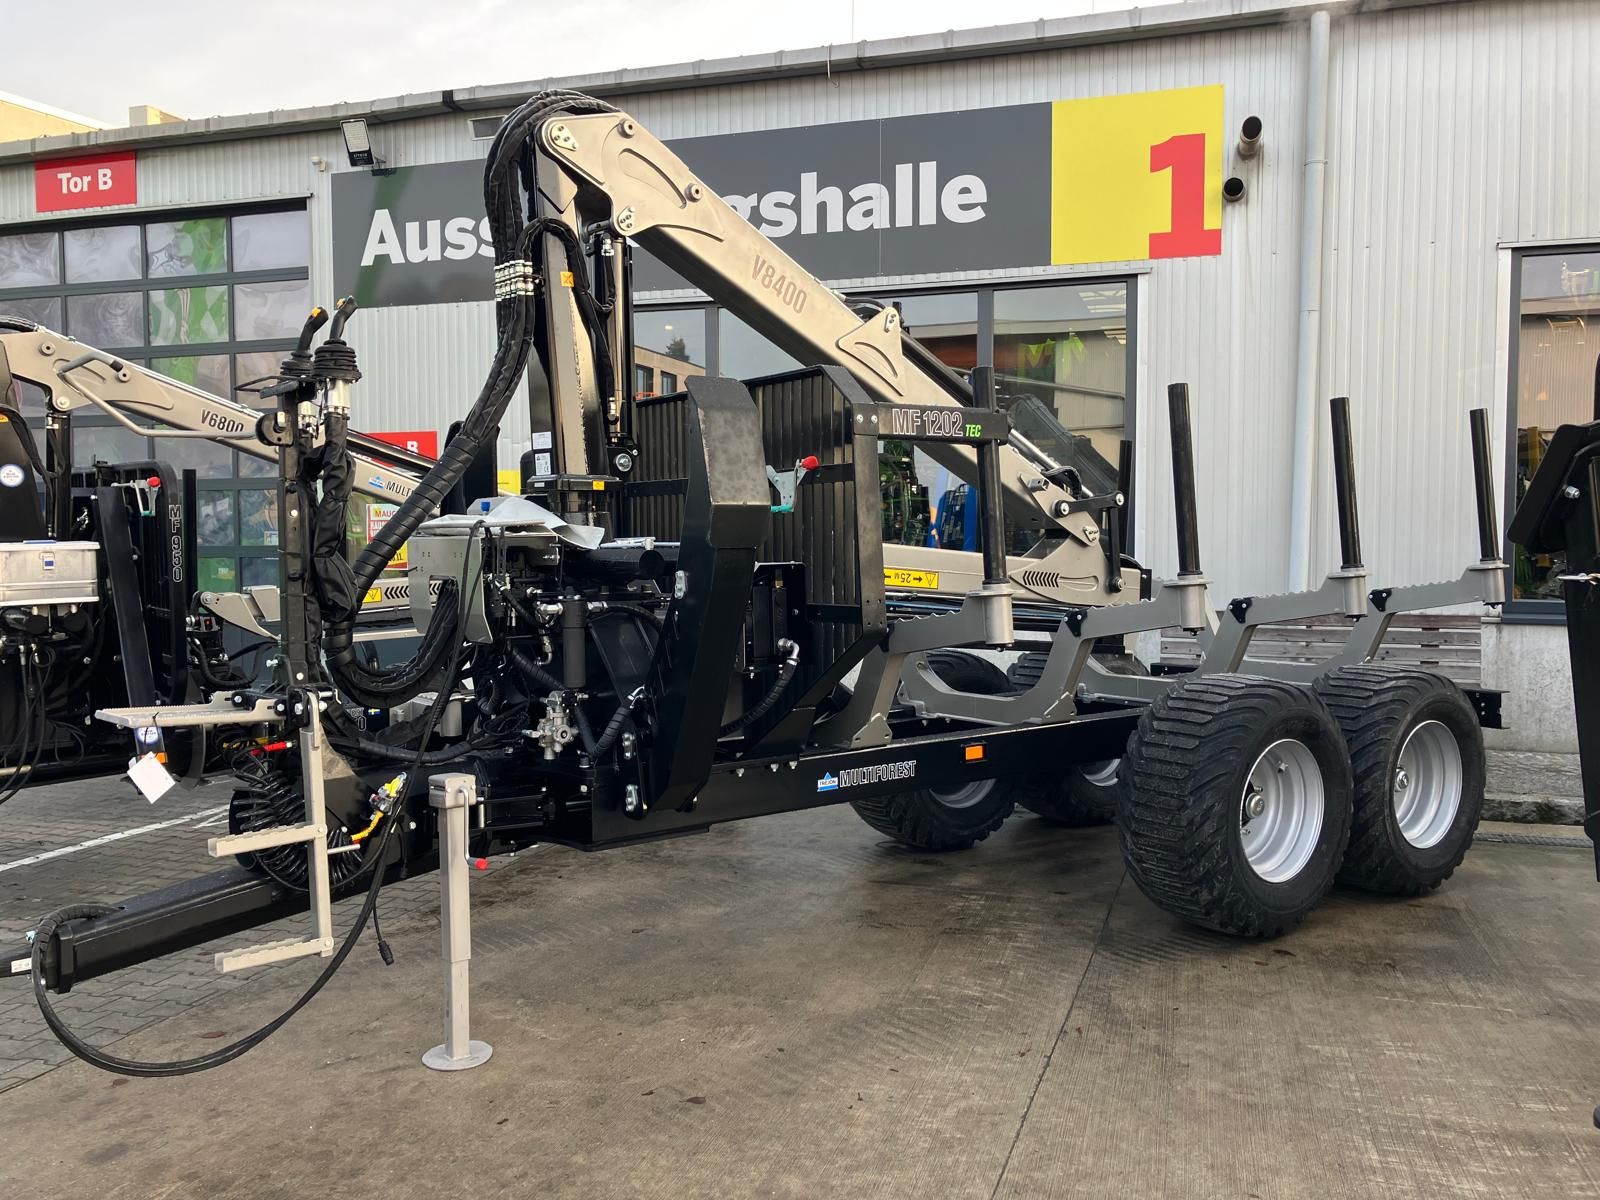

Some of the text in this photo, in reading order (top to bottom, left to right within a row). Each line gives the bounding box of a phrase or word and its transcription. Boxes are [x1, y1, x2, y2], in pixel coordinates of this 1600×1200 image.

[57, 168, 113, 194] Tor B
[1149, 133, 1222, 259] 1
[752, 254, 807, 314] V8400
[201, 409, 244, 433] V6800
[892, 408, 982, 438] MF 1202 TEC
[169, 504, 183, 583] MF 950
[839, 760, 917, 788] MULTIFOREST
